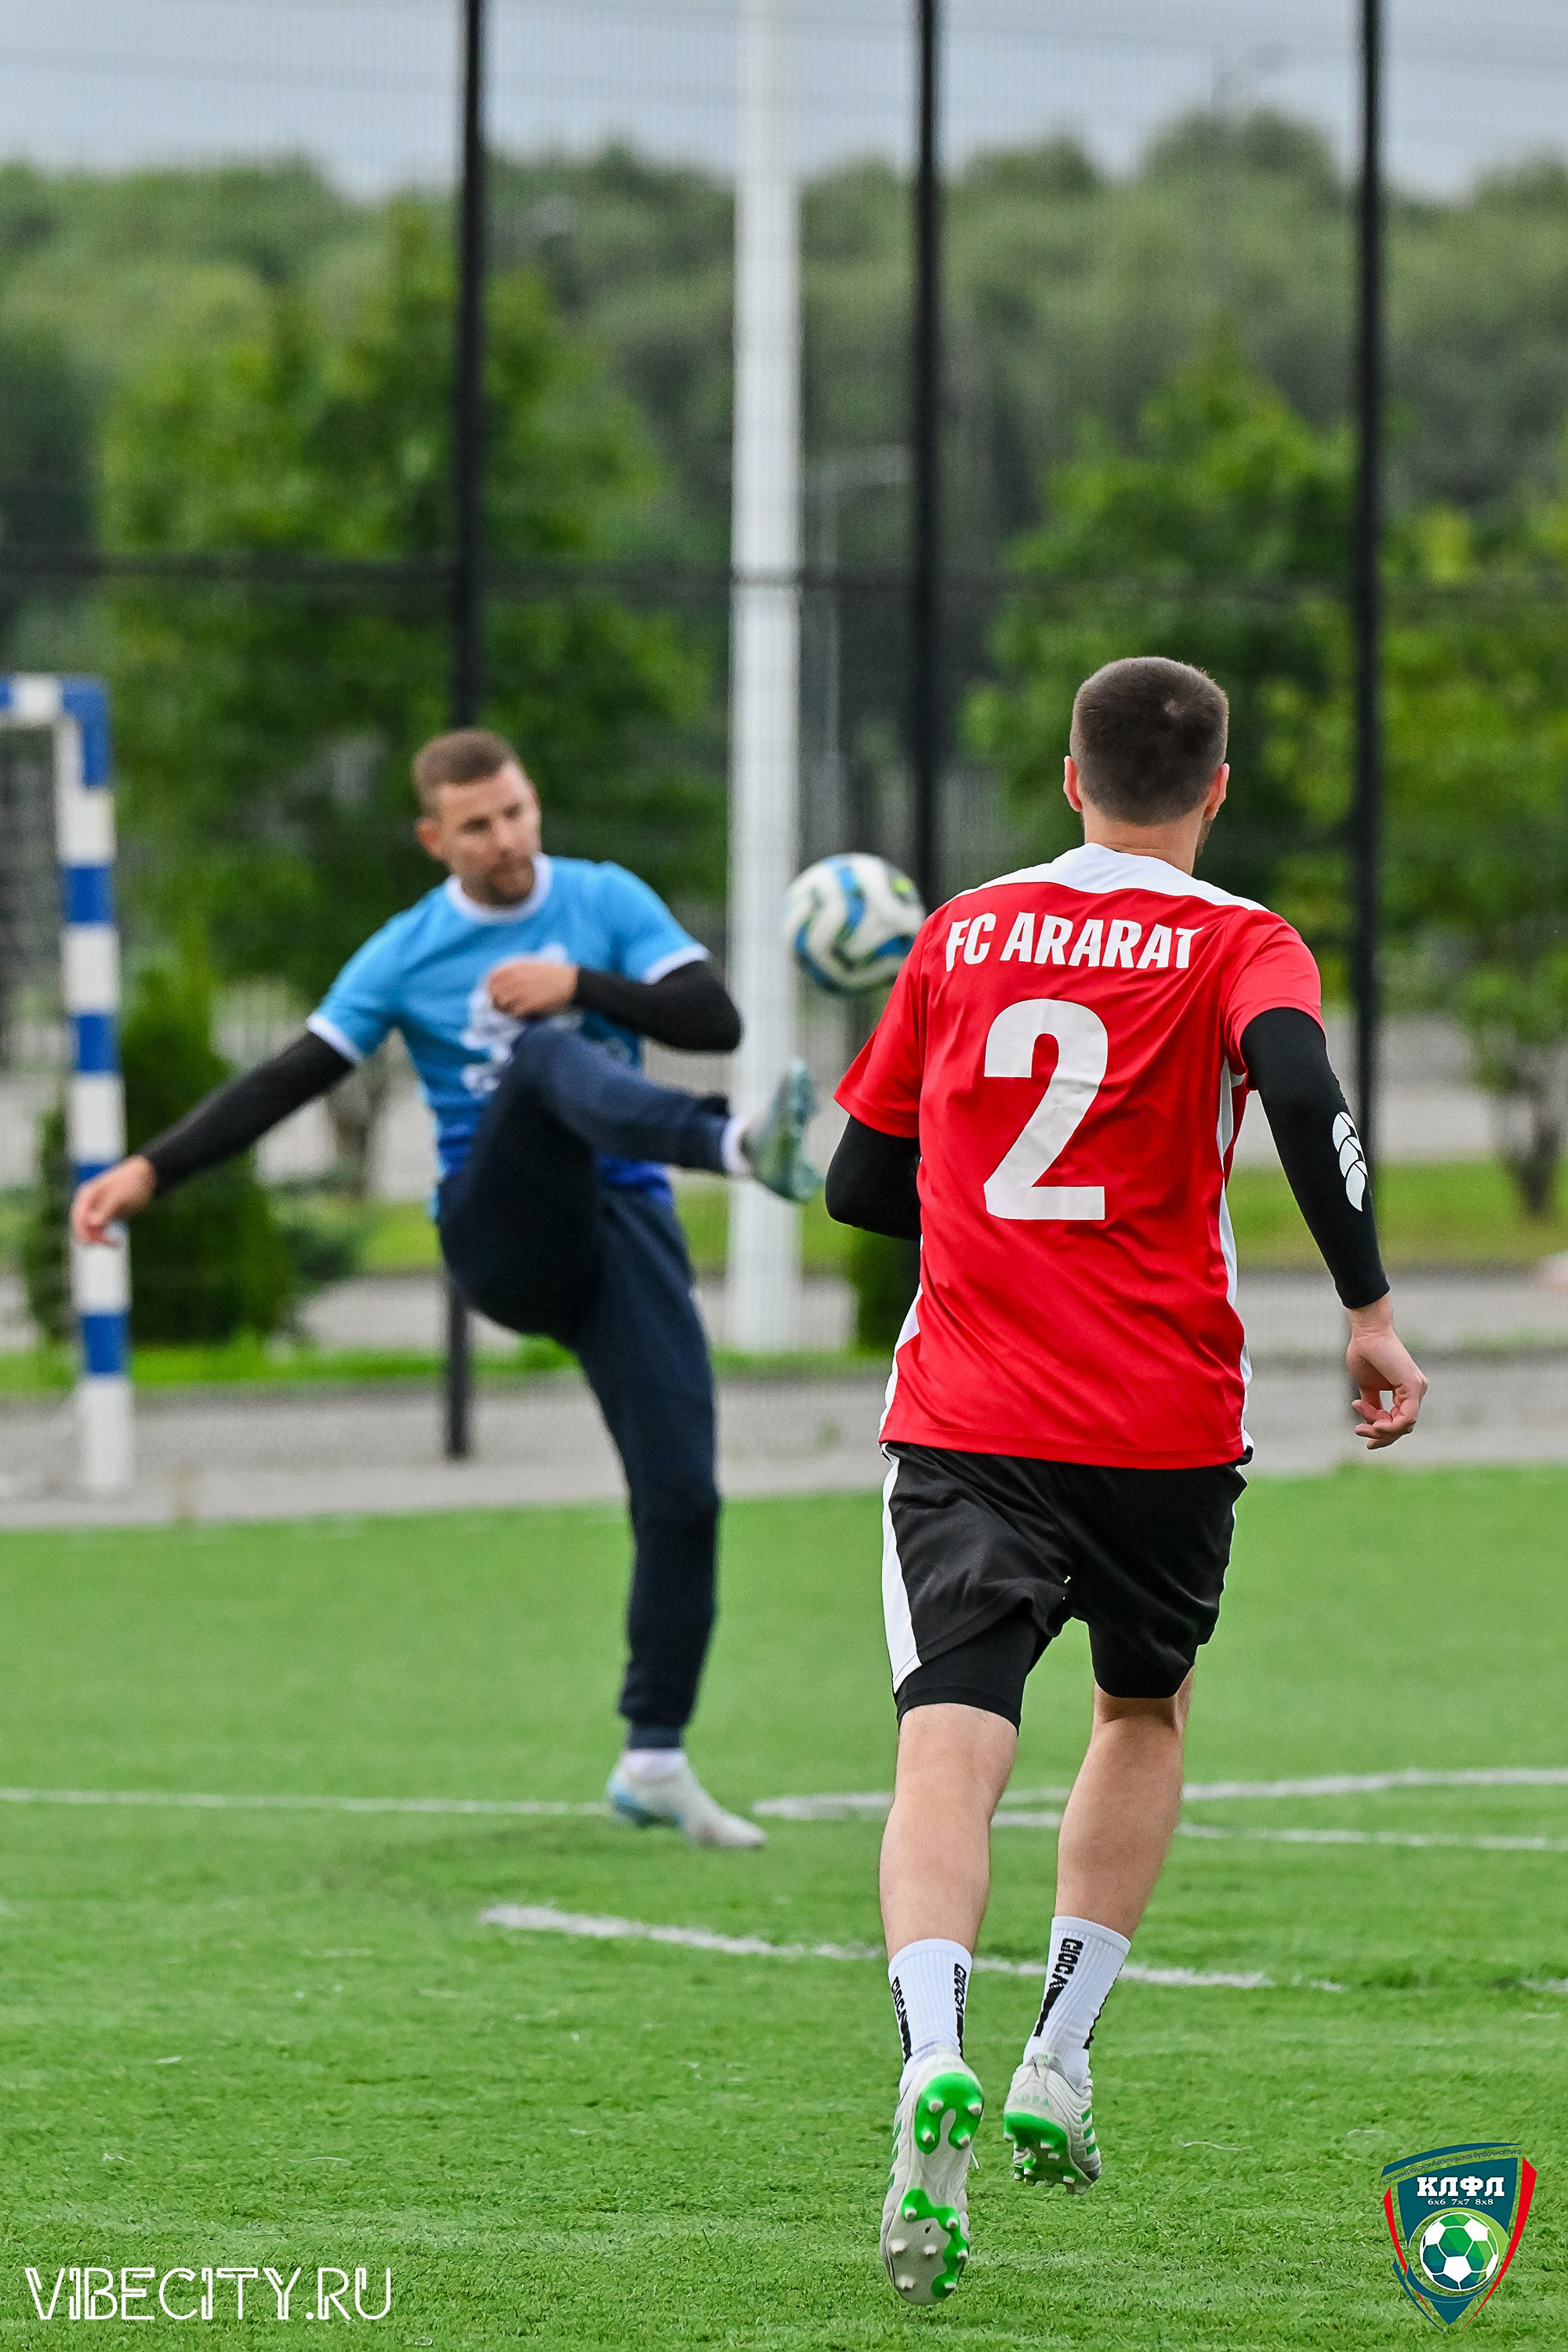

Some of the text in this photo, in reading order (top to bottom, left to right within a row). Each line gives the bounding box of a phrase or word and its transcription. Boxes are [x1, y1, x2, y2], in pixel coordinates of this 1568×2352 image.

[946, 912, 1205, 972] FC ARARAT
[983, 998, 1109, 1221] 2
